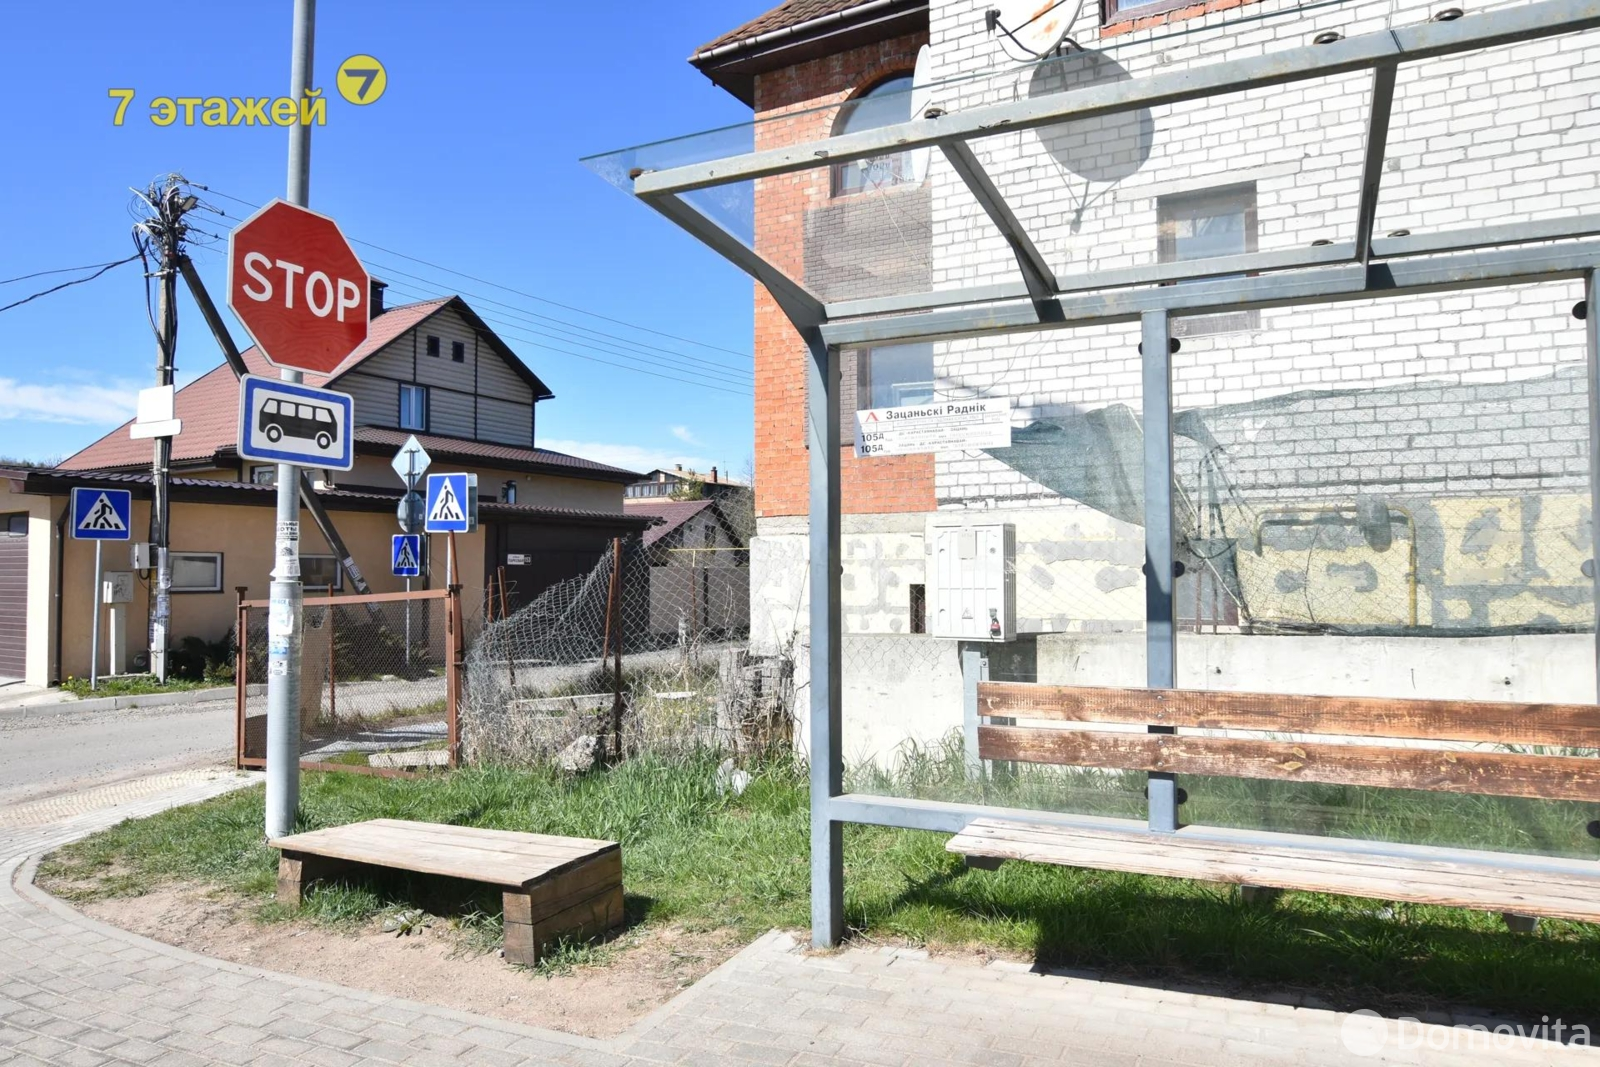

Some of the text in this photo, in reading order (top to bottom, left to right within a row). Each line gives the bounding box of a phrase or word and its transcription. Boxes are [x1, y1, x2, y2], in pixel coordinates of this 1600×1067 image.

[242, 251, 360, 323] STOP
[886, 406, 943, 420] Зацаньскі
[947, 402, 986, 414] Раднік
